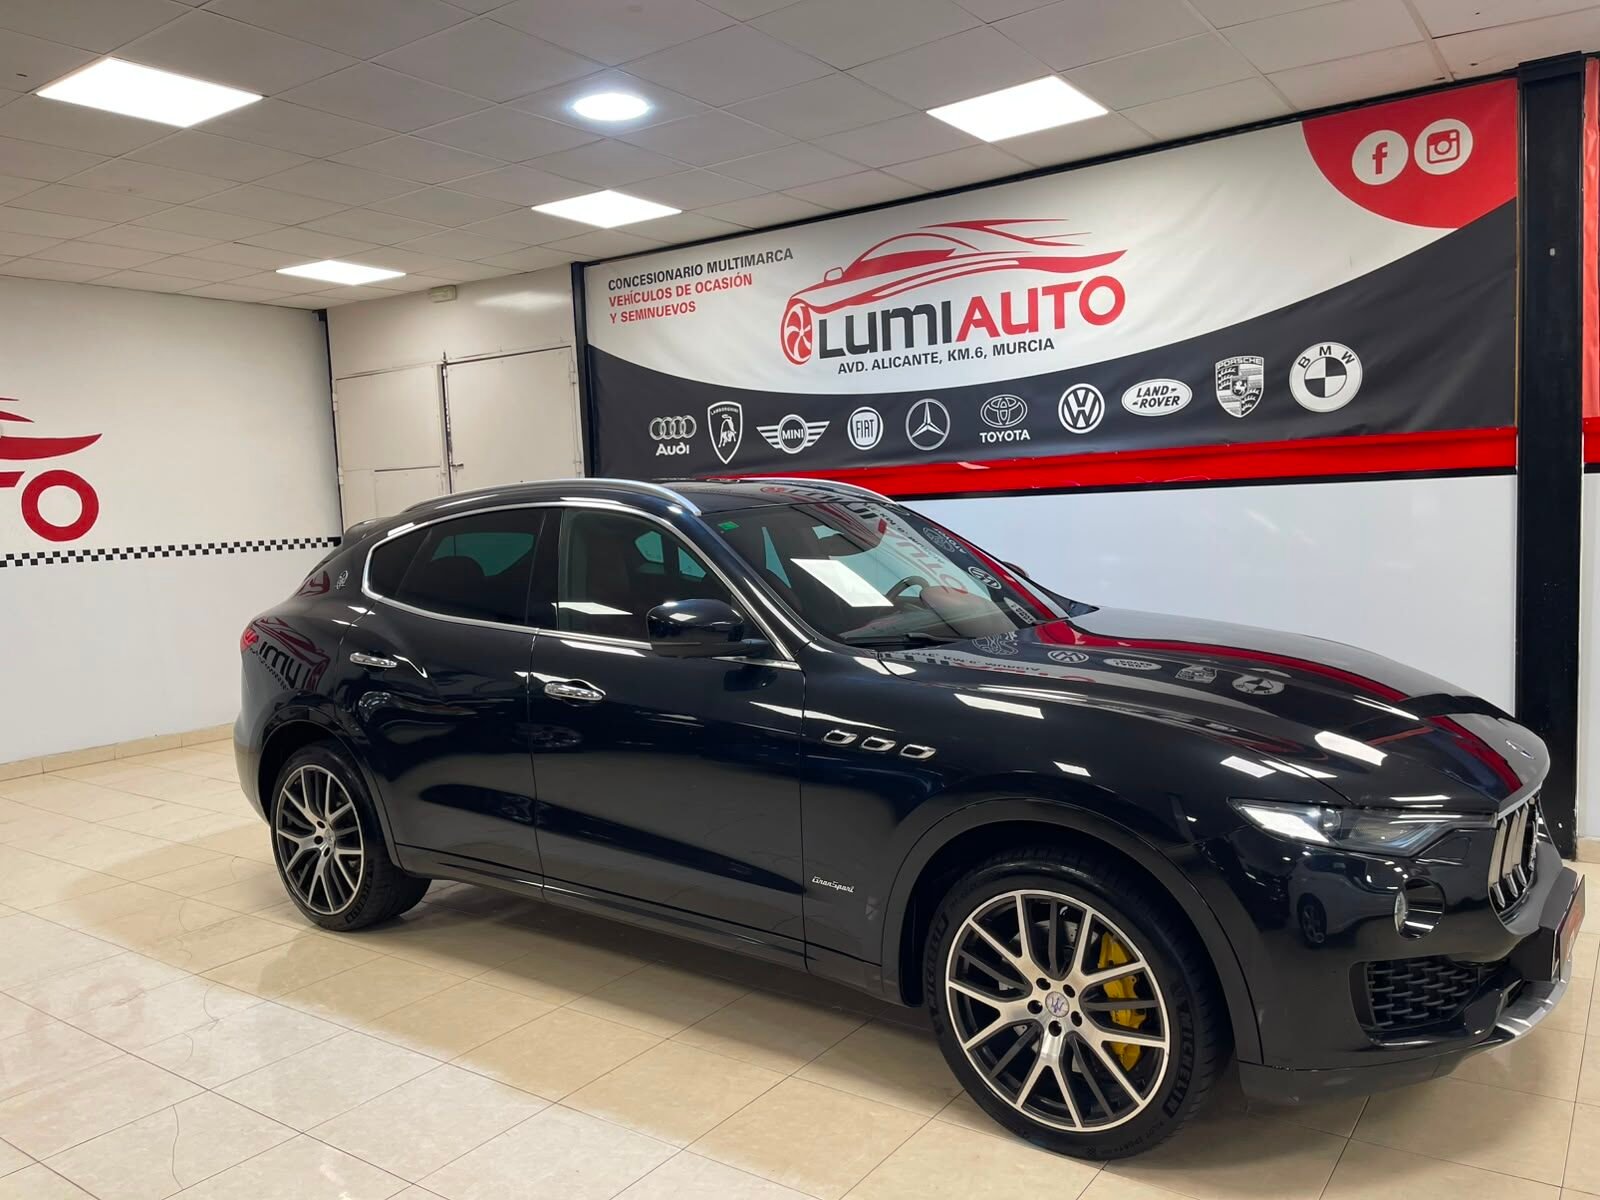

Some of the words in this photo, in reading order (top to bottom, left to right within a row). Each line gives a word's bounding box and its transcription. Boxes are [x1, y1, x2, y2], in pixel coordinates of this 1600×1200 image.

[608, 264, 703, 291] CONCESIONARIO
[706, 247, 794, 275] MULTIMARCA
[609, 286, 672, 308] VEHÍCULOS
[676, 284, 692, 297] DE
[695, 272, 753, 294] OCASIÓN
[610, 313, 617, 324] Y
[620, 300, 696, 323] SEMINUEVOS
[837, 360, 868, 375] AVD.
[871, 352, 943, 371] ALICANTE,
[947, 346, 988, 362] KM.6,
[992, 337, 1055, 357] MURCIA
[1217, 356, 1262, 370] PORSCHE
[781, 428, 805, 440] MINI
[855, 418, 876, 439] FIAT
[979, 429, 1031, 443] TOYOTA
[655, 443, 690, 457] Audi
